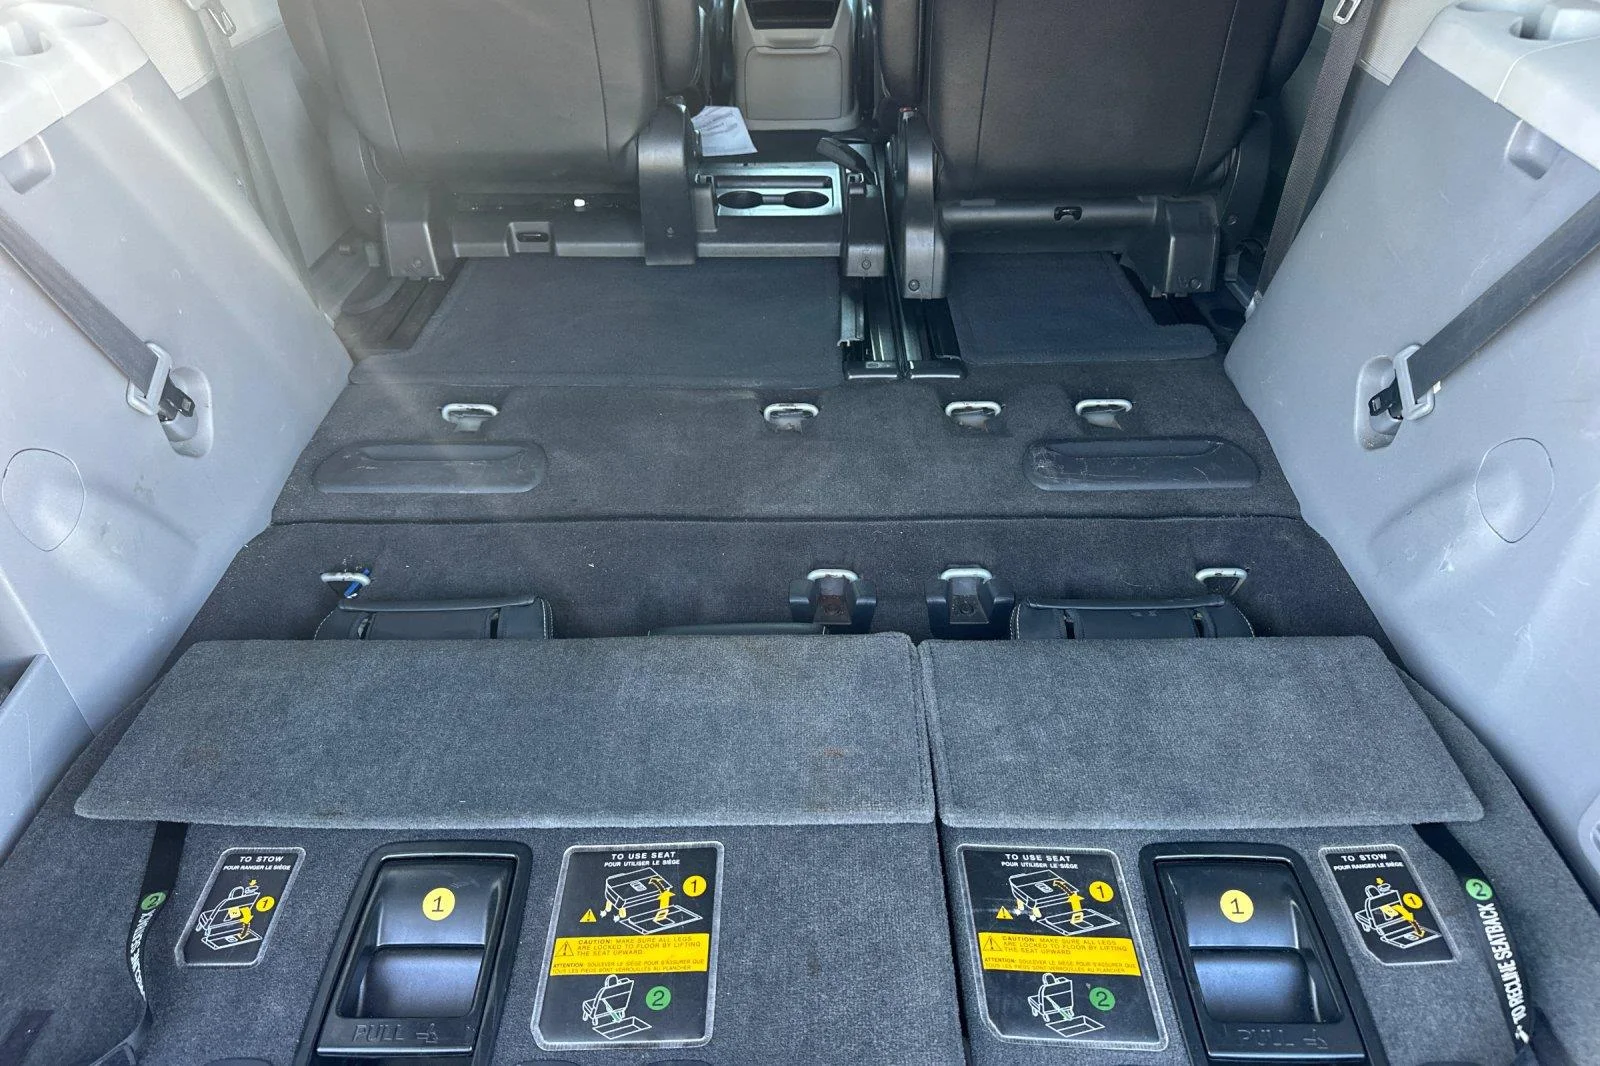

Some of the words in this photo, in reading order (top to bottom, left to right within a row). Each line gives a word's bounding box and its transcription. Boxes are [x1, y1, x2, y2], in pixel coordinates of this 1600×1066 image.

[1472, 883, 1486, 897] 2
[432, 896, 444, 912] 1
[1230, 898, 1244, 914] 1
[1477, 903, 1513, 960] SEATBACK
[1497, 960, 1524, 1008] RECLINE
[652, 990, 664, 1006] 2
[1096, 992, 1110, 1007] 2
[1511, 1005, 1527, 1025] TO
[353, 1024, 404, 1042] PULL
